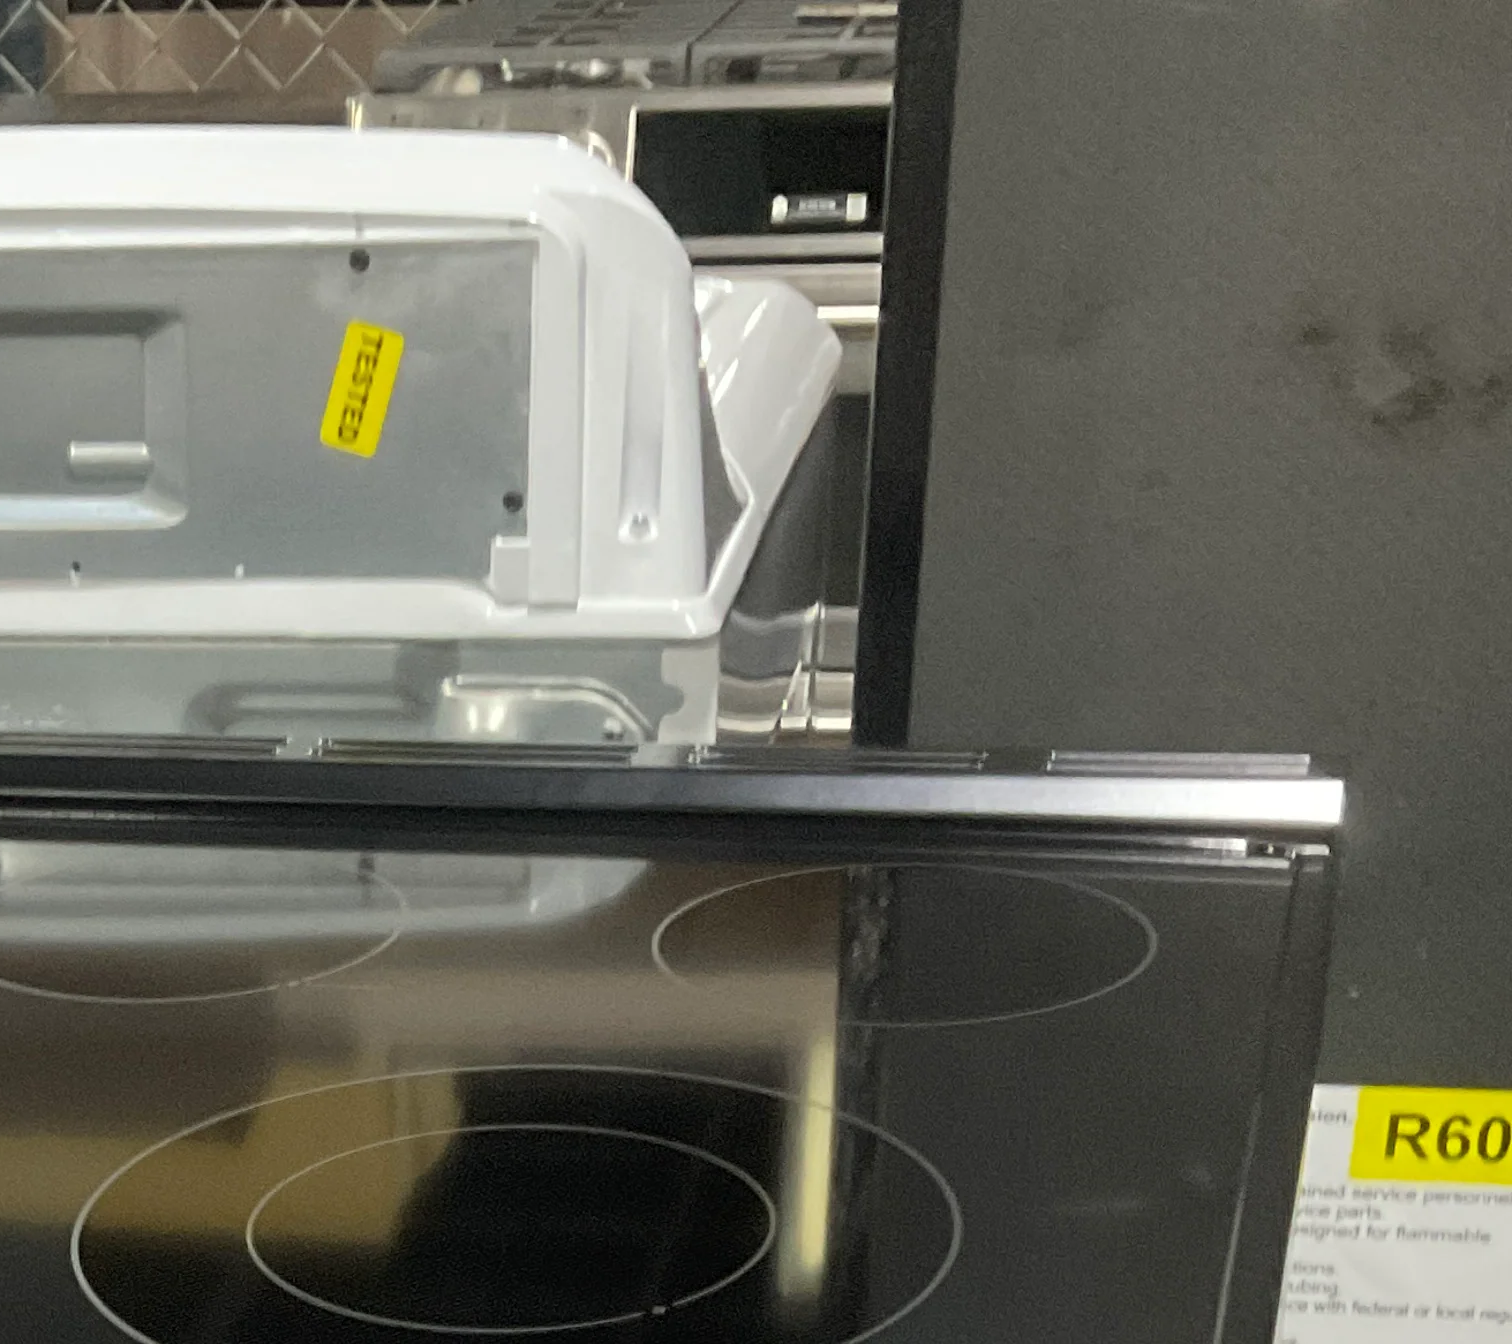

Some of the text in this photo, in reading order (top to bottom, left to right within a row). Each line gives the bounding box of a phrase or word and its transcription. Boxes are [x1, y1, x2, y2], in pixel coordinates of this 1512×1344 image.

[337, 331, 384, 445] TESTED
[1351, 1186, 1417, 1202] service
[1366, 1225, 1390, 1241] for
[1395, 1226, 1491, 1244] flammable
[1313, 1301, 1347, 1316] with
